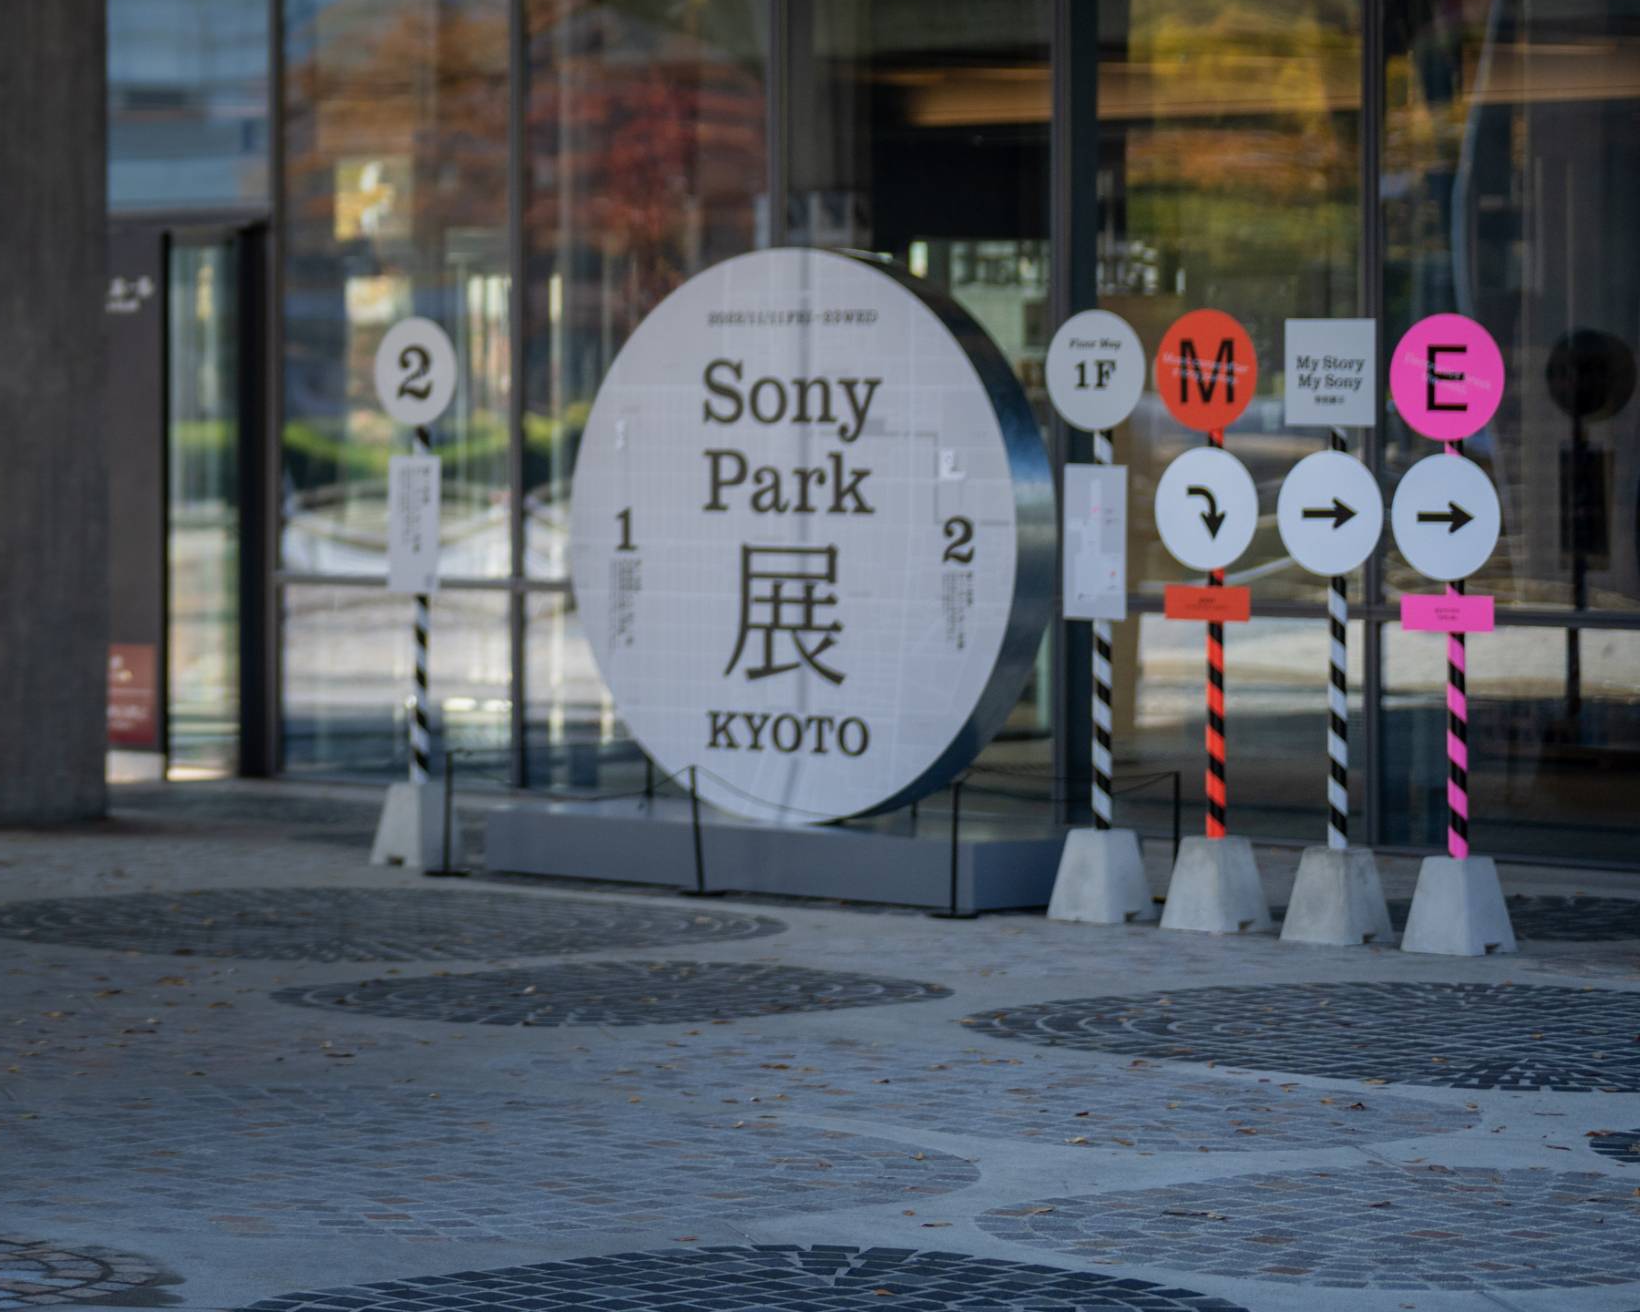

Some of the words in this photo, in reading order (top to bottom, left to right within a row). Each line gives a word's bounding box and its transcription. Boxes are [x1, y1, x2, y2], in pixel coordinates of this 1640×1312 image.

[396, 344, 433, 400] 2
[1074, 359, 1116, 390] 1F
[1180, 338, 1235, 404] M
[1296, 355, 1319, 371] My
[1322, 355, 1366, 374] Story
[1298, 373, 1322, 390] My
[1324, 374, 1363, 391] Sony
[1426, 344, 1468, 411] E
[702, 358, 883, 443] Sony
[701, 449, 876, 515] Park
[614, 505, 639, 552] 1
[942, 514, 975, 564] 2
[723, 542, 847, 686] 展
[706, 710, 871, 758] KYOTO
